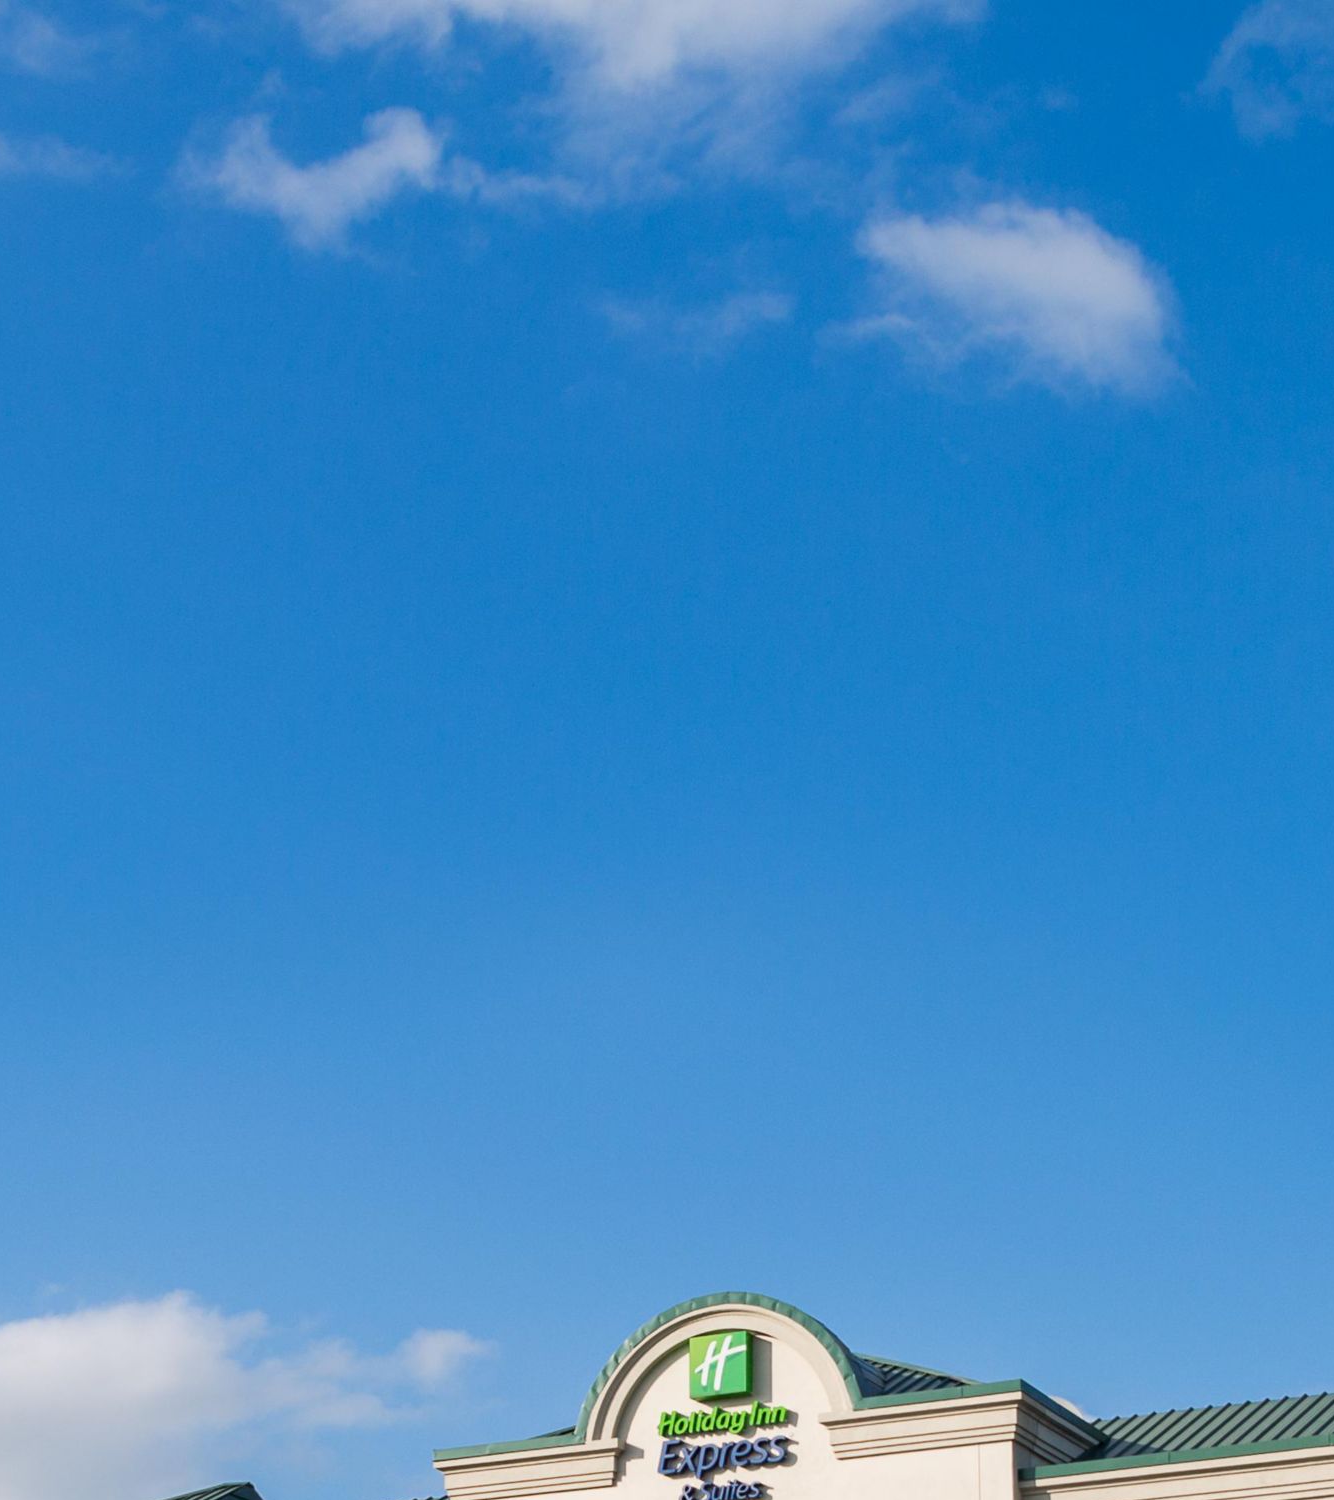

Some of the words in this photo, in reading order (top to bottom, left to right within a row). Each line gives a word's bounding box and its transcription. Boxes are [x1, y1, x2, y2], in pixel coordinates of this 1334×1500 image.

[658, 1406, 746, 1437] Holiday
[749, 1401, 788, 1426] Inn
[658, 1435, 787, 1479] Express
